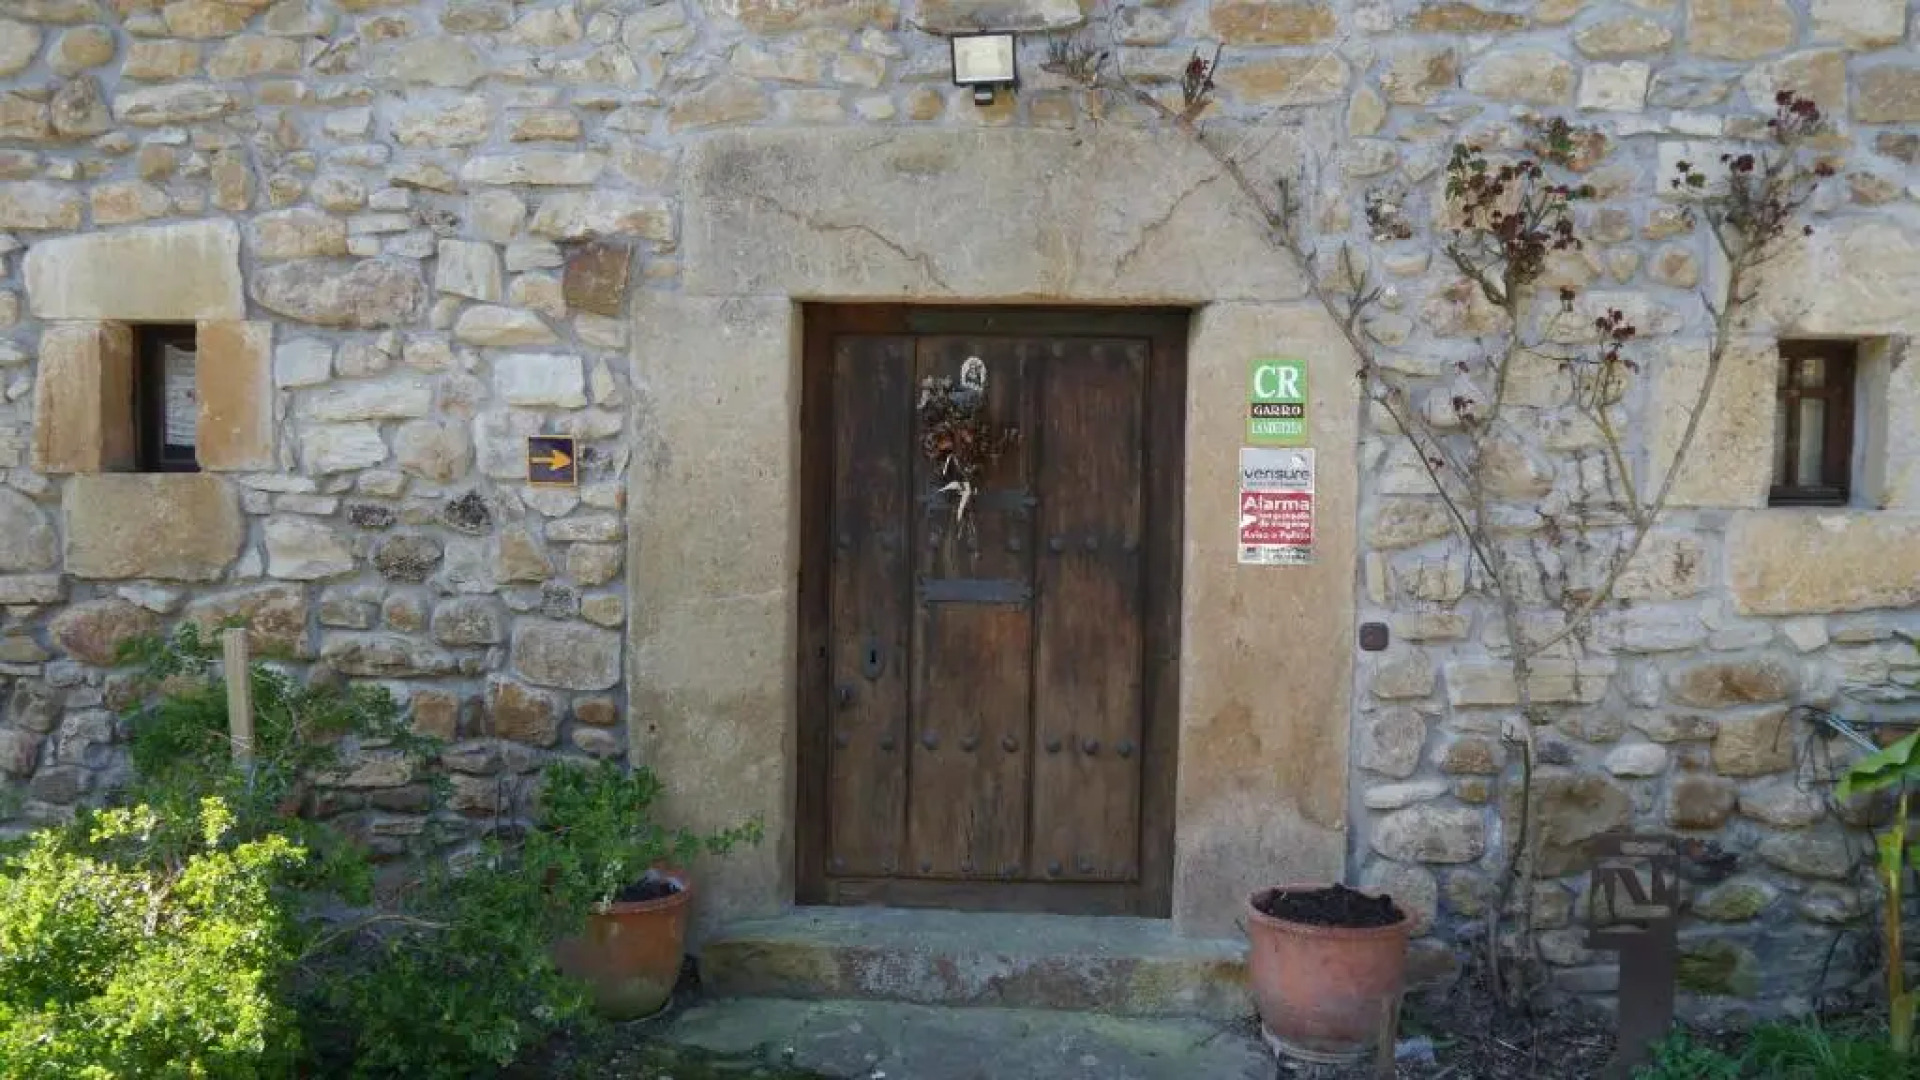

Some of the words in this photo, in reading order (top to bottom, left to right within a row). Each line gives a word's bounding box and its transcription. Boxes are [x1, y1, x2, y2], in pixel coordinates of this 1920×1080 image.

[1253, 365, 1301, 398] CR
[1253, 404, 1302, 415] GARRO
[1244, 494, 1310, 511] Alarma
